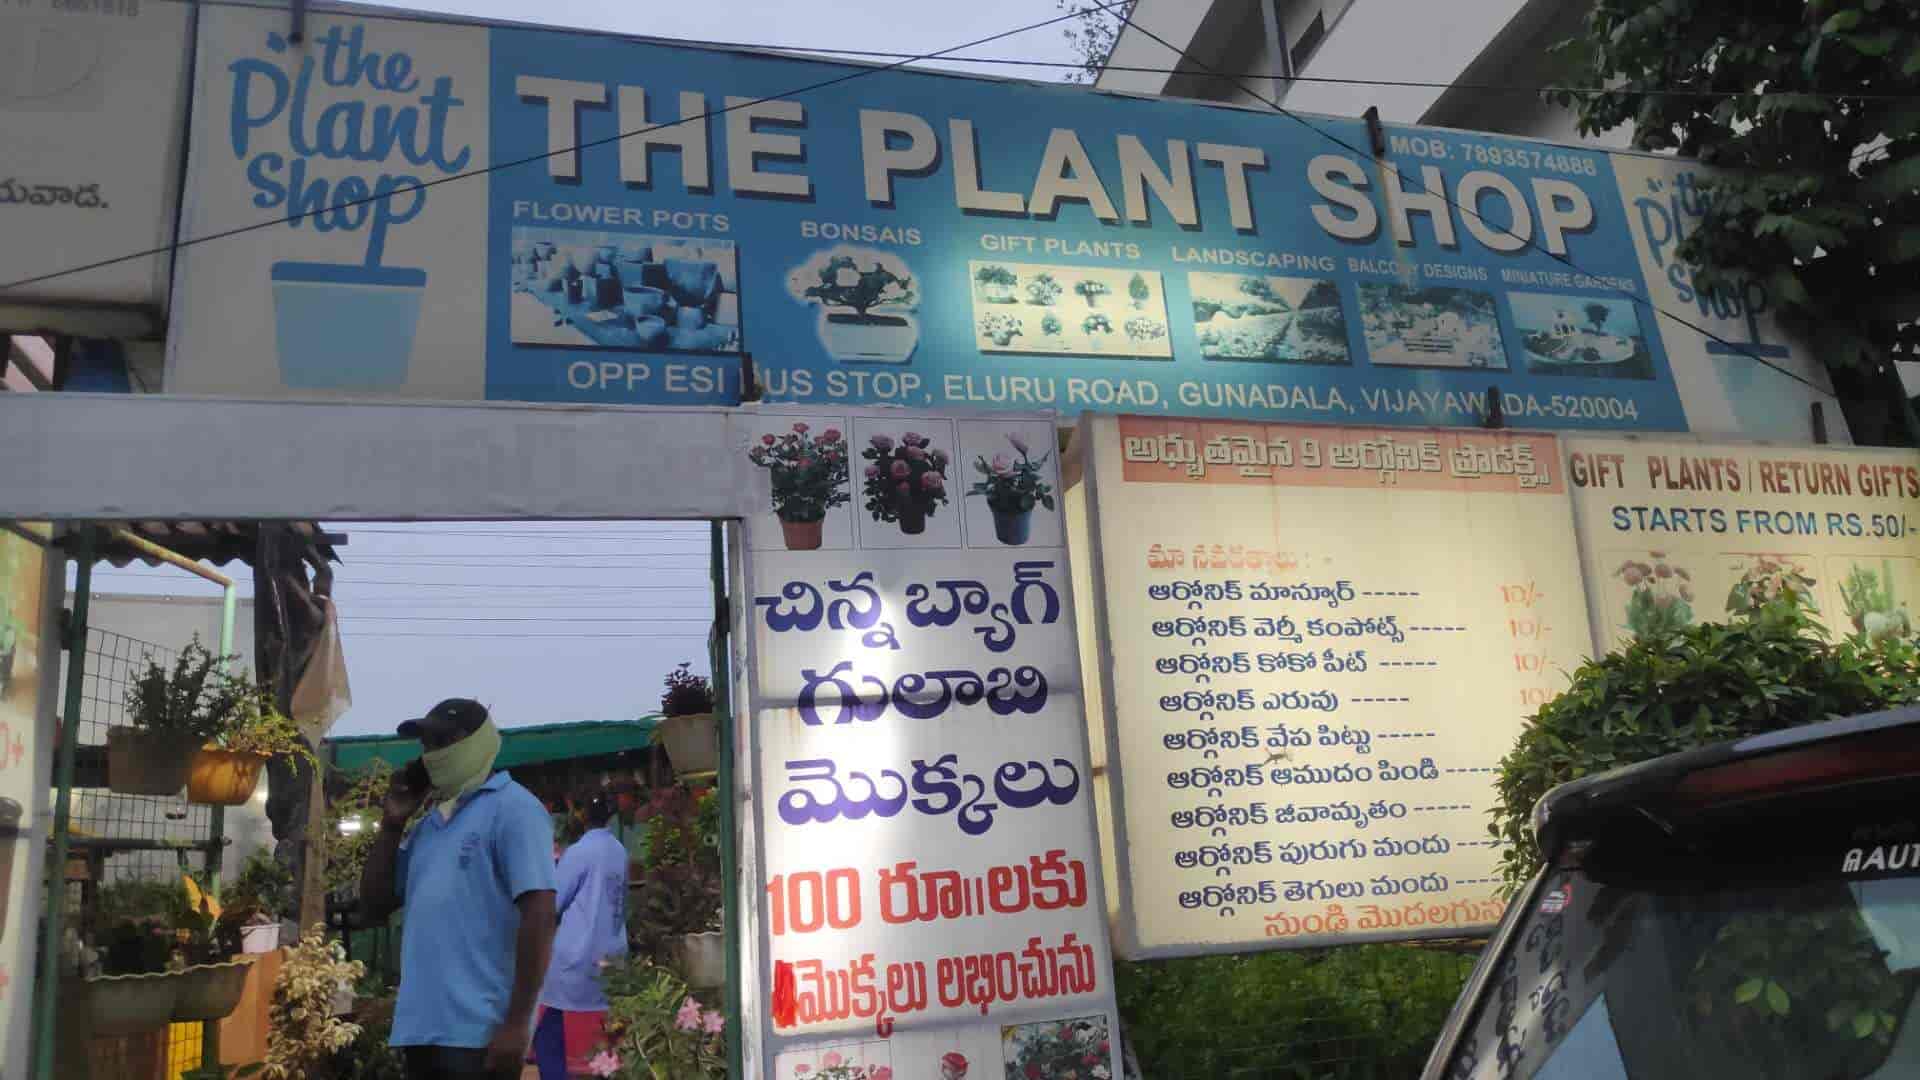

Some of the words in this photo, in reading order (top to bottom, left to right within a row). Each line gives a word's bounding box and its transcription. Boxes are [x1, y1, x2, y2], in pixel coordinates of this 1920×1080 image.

[515, 74, 813, 202] THE
[859, 108, 1268, 235] PLANT
[1307, 154, 1596, 258] SHOP
[512, 200, 643, 227] FLOWER
[652, 209, 730, 233] POTS
[801, 221, 922, 247] BONSAIS
[981, 232, 1036, 254] GIFT
[1044, 236, 1142, 260] PLANTS
[1172, 246, 1336, 273] LANDSCAPING
[1423, 263, 1489, 281] DESIGNS
[567, 361, 651, 393] OPP
[664, 364, 725, 394] ESI
[826, 370, 933, 404] STOP,
[944, 375, 1056, 403] ELURU
[1068, 379, 1168, 411] ROAD,
[1178, 381, 1354, 413] GUNADALA,
[1360, 385, 1640, 421] VIJAYAWDA-520004
[1569, 452, 1625, 489] GIFT
[1648, 456, 1742, 493] PLANTS
[1758, 460, 1853, 497] RETURN
[1857, 463, 1920, 499] GIFTS
[1611, 505, 1729, 535] STARTS
[1735, 509, 1818, 536] FROM
[755, 570, 902, 651] చిన్న
[905, 560, 1060, 653] బ్యాగ్
[1256, 651, 1317, 673] కోకో
[1262, 689, 1339, 712] ఎరువు
[778, 753, 1080, 836] మొక్కలు
[1278, 838, 1367, 866] పురుగు
[1373, 833, 1451, 858] మందు
[1369, 871, 1449, 896] మందు
[765, 866, 862, 936] 100
[796, 952, 928, 1039] మొక్కలు
